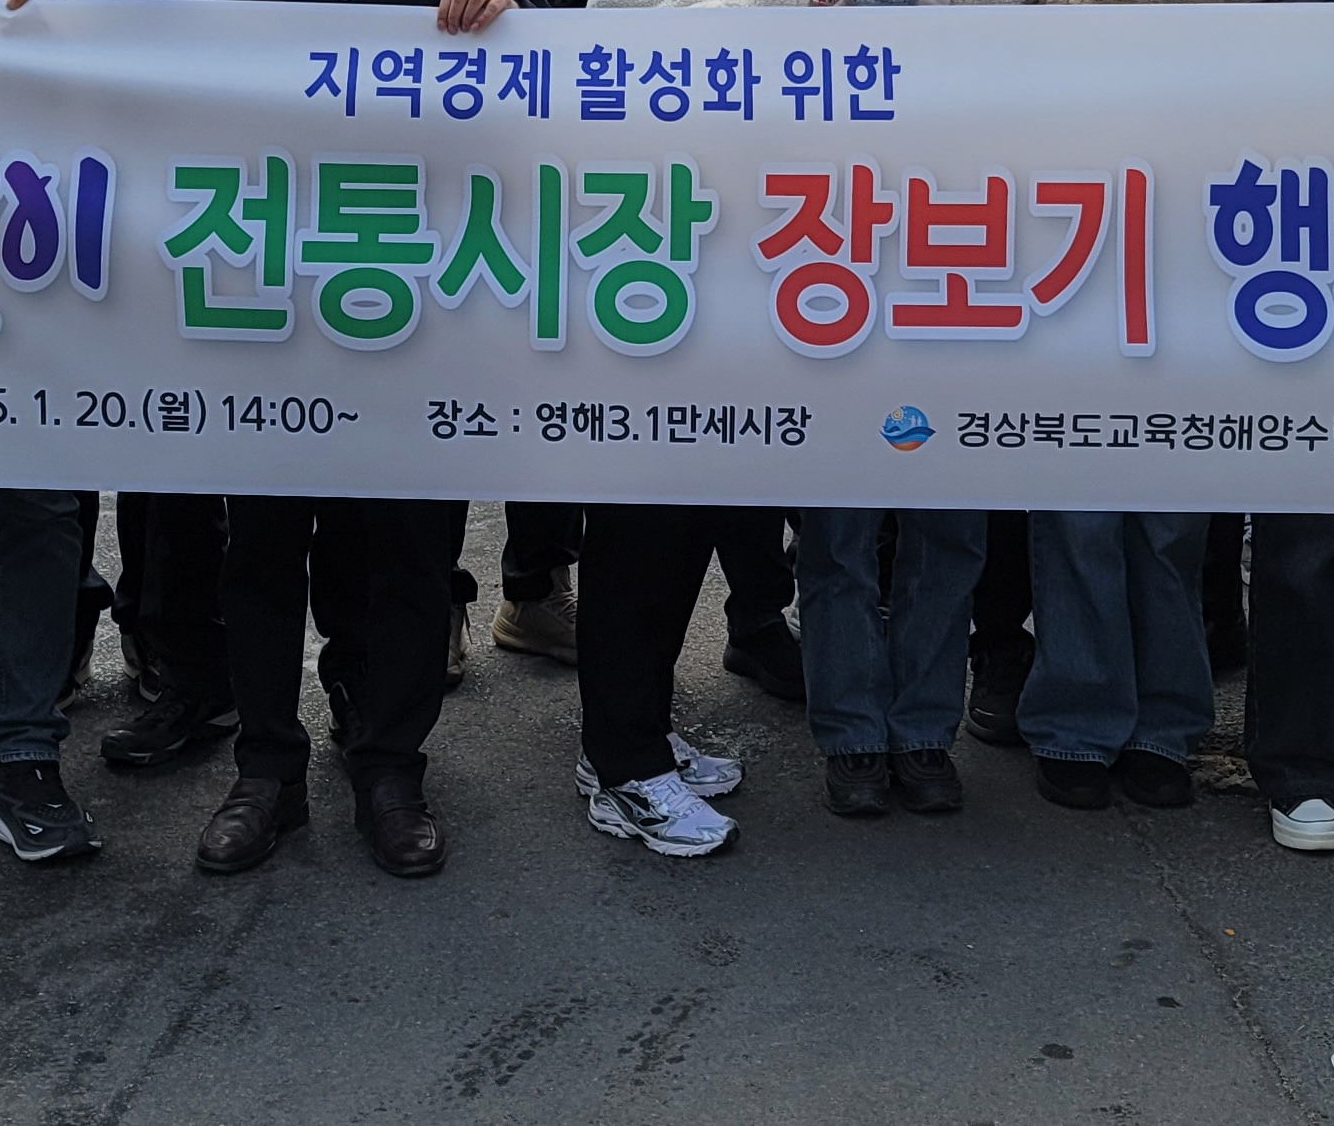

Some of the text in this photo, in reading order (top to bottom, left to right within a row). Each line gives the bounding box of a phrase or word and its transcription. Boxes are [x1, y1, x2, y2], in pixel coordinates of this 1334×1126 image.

[305, 43, 902, 121] 지역경제 활성화 위한
[163, 156, 713, 346] 전통시장
[757, 163, 1149, 347] 장보기
[33, 386, 61, 427] 1.
[75, 388, 207, 436] 20.(월)
[221, 393, 359, 436] 14:00~
[427, 397, 498, 441] 장소
[535, 400, 811, 446] 영해3.1만세시장
